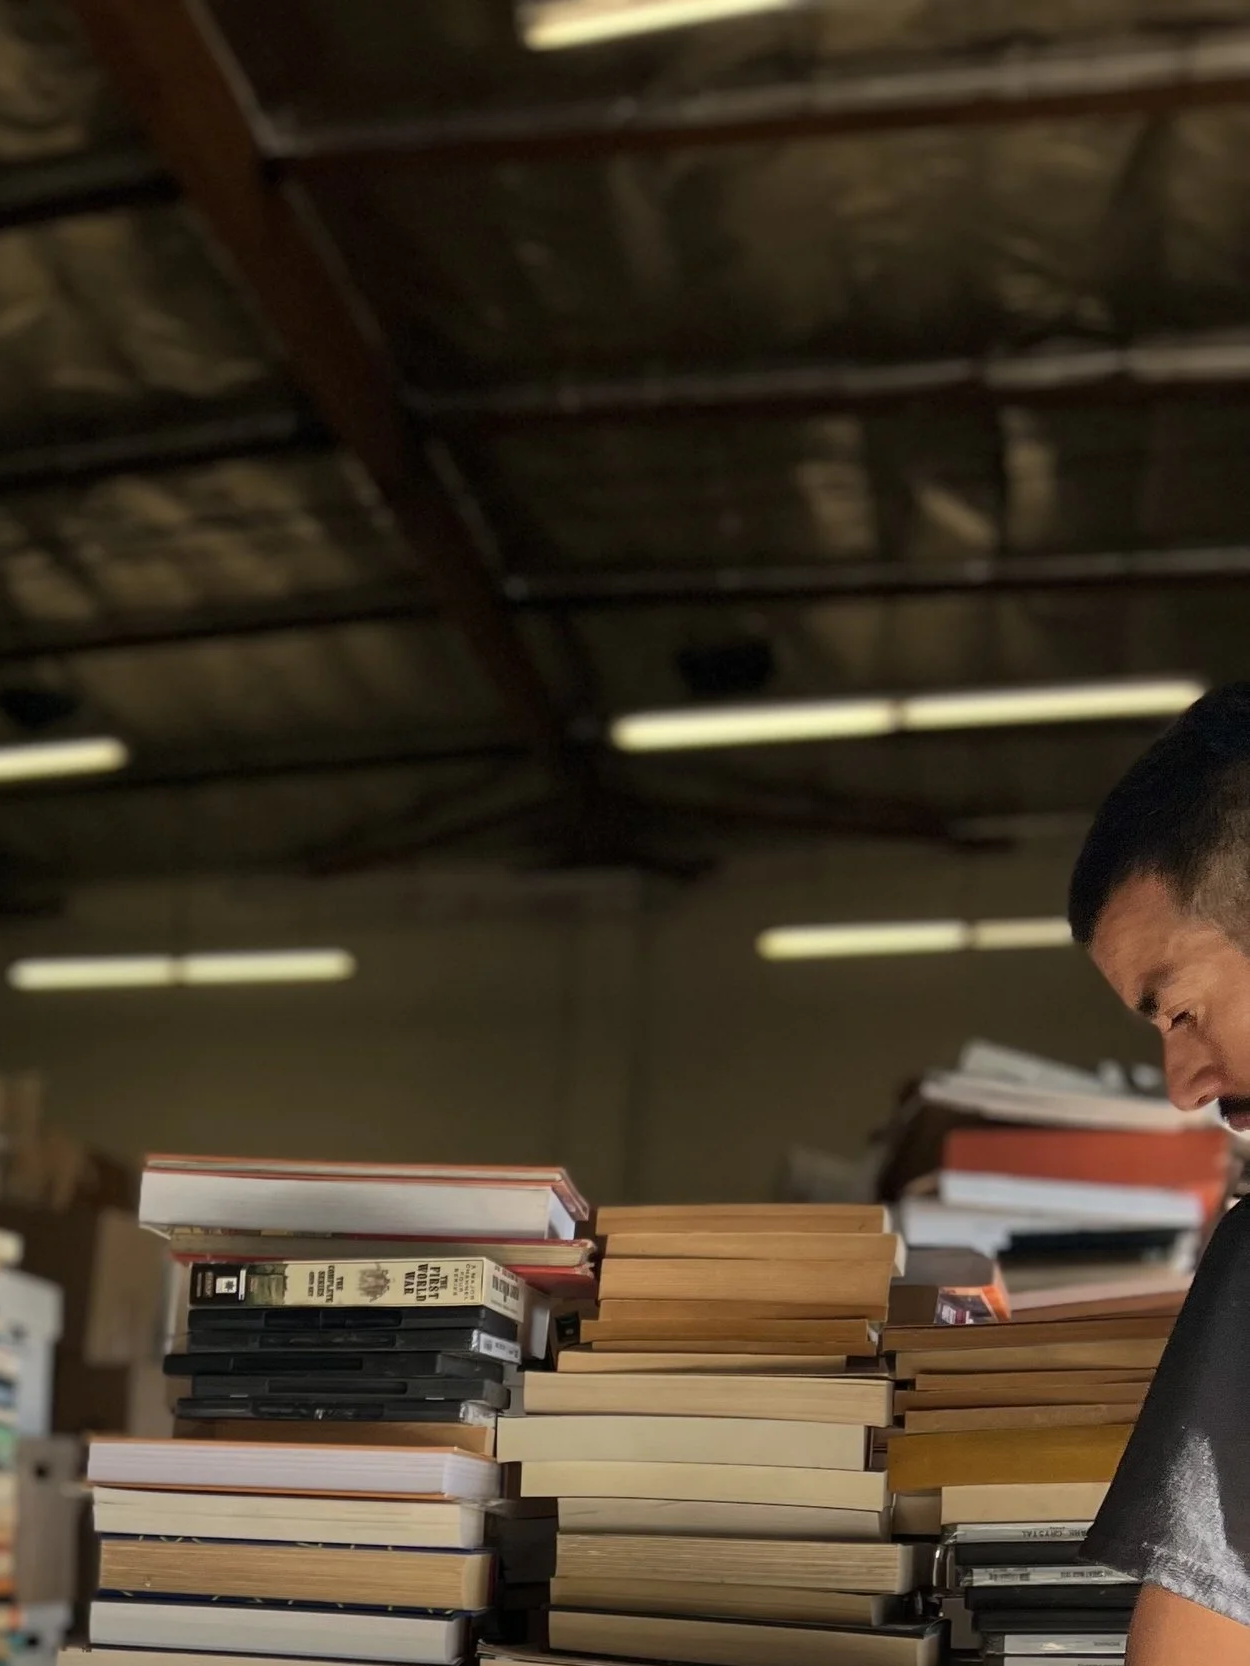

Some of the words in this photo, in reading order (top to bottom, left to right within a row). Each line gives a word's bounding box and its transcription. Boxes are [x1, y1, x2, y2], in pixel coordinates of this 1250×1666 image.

[317, 1271, 325, 1297] SERIES
[325, 1265, 336, 1303] COMPLETE
[336, 1275, 344, 1291] THE
[403, 1271, 416, 1295] WAR
[415, 1263, 429, 1302] WORLD
[428, 1266, 441, 1300] FIRST
[440, 1275, 449, 1290] THE
[1022, 1529, 1063, 1538] CRYSTAL
